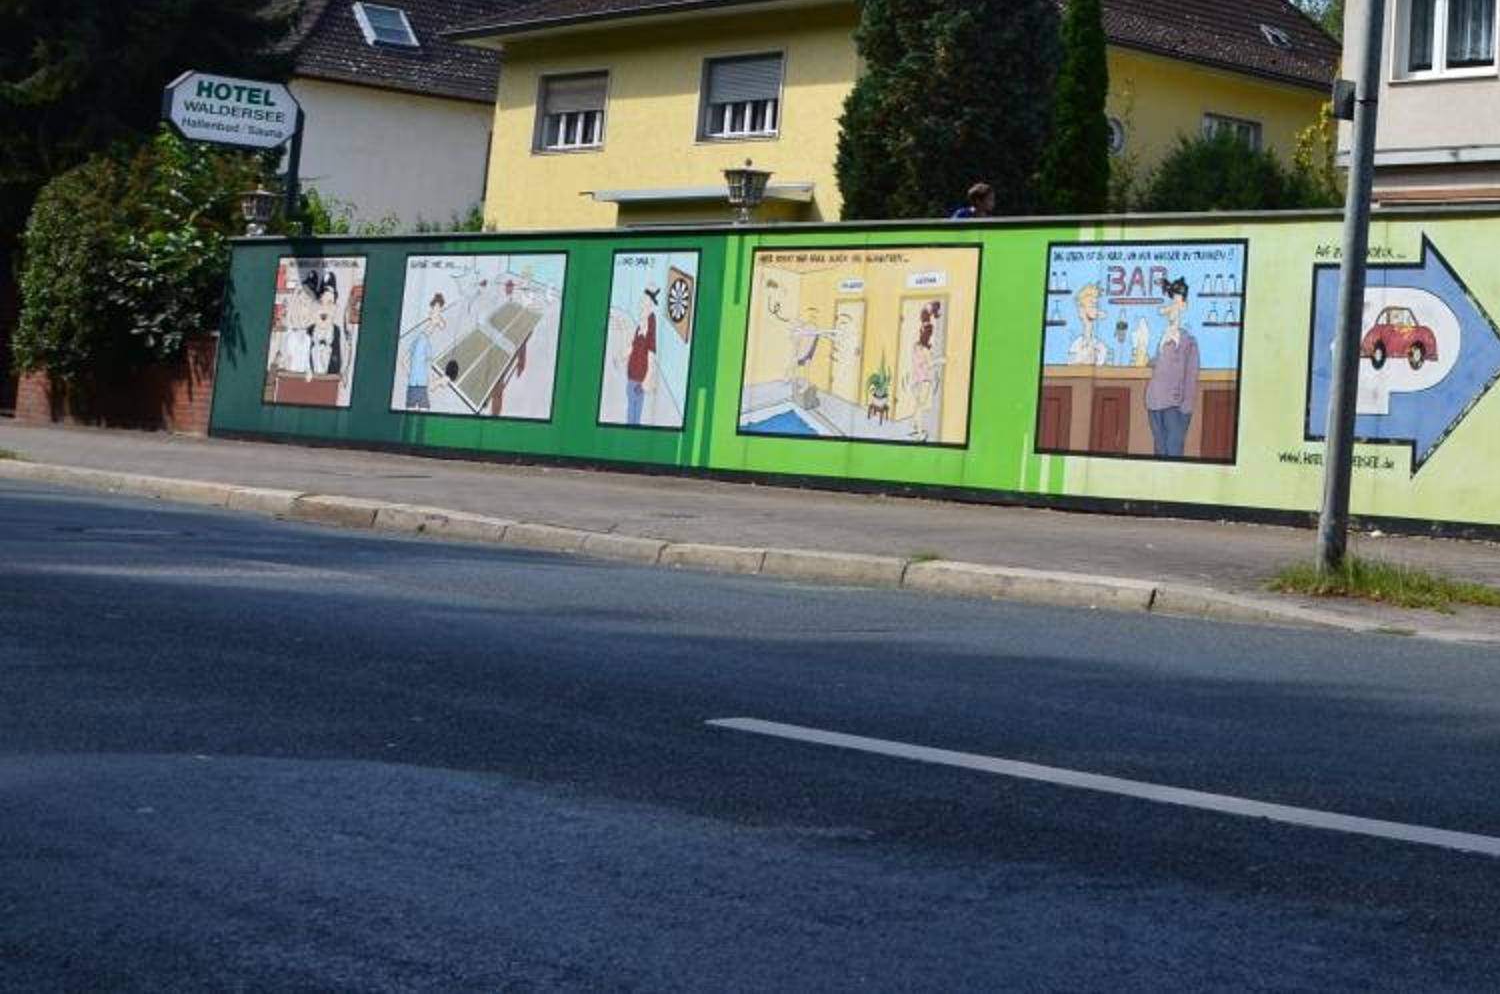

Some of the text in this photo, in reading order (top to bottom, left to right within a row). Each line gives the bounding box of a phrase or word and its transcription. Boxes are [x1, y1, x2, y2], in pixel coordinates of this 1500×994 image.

[196, 80, 276, 106] HOTEL
[184, 100, 286, 123] WALDERSEE
[181, 117, 240, 133] Hallenbad
[1107, 265, 1168, 297] BAR
